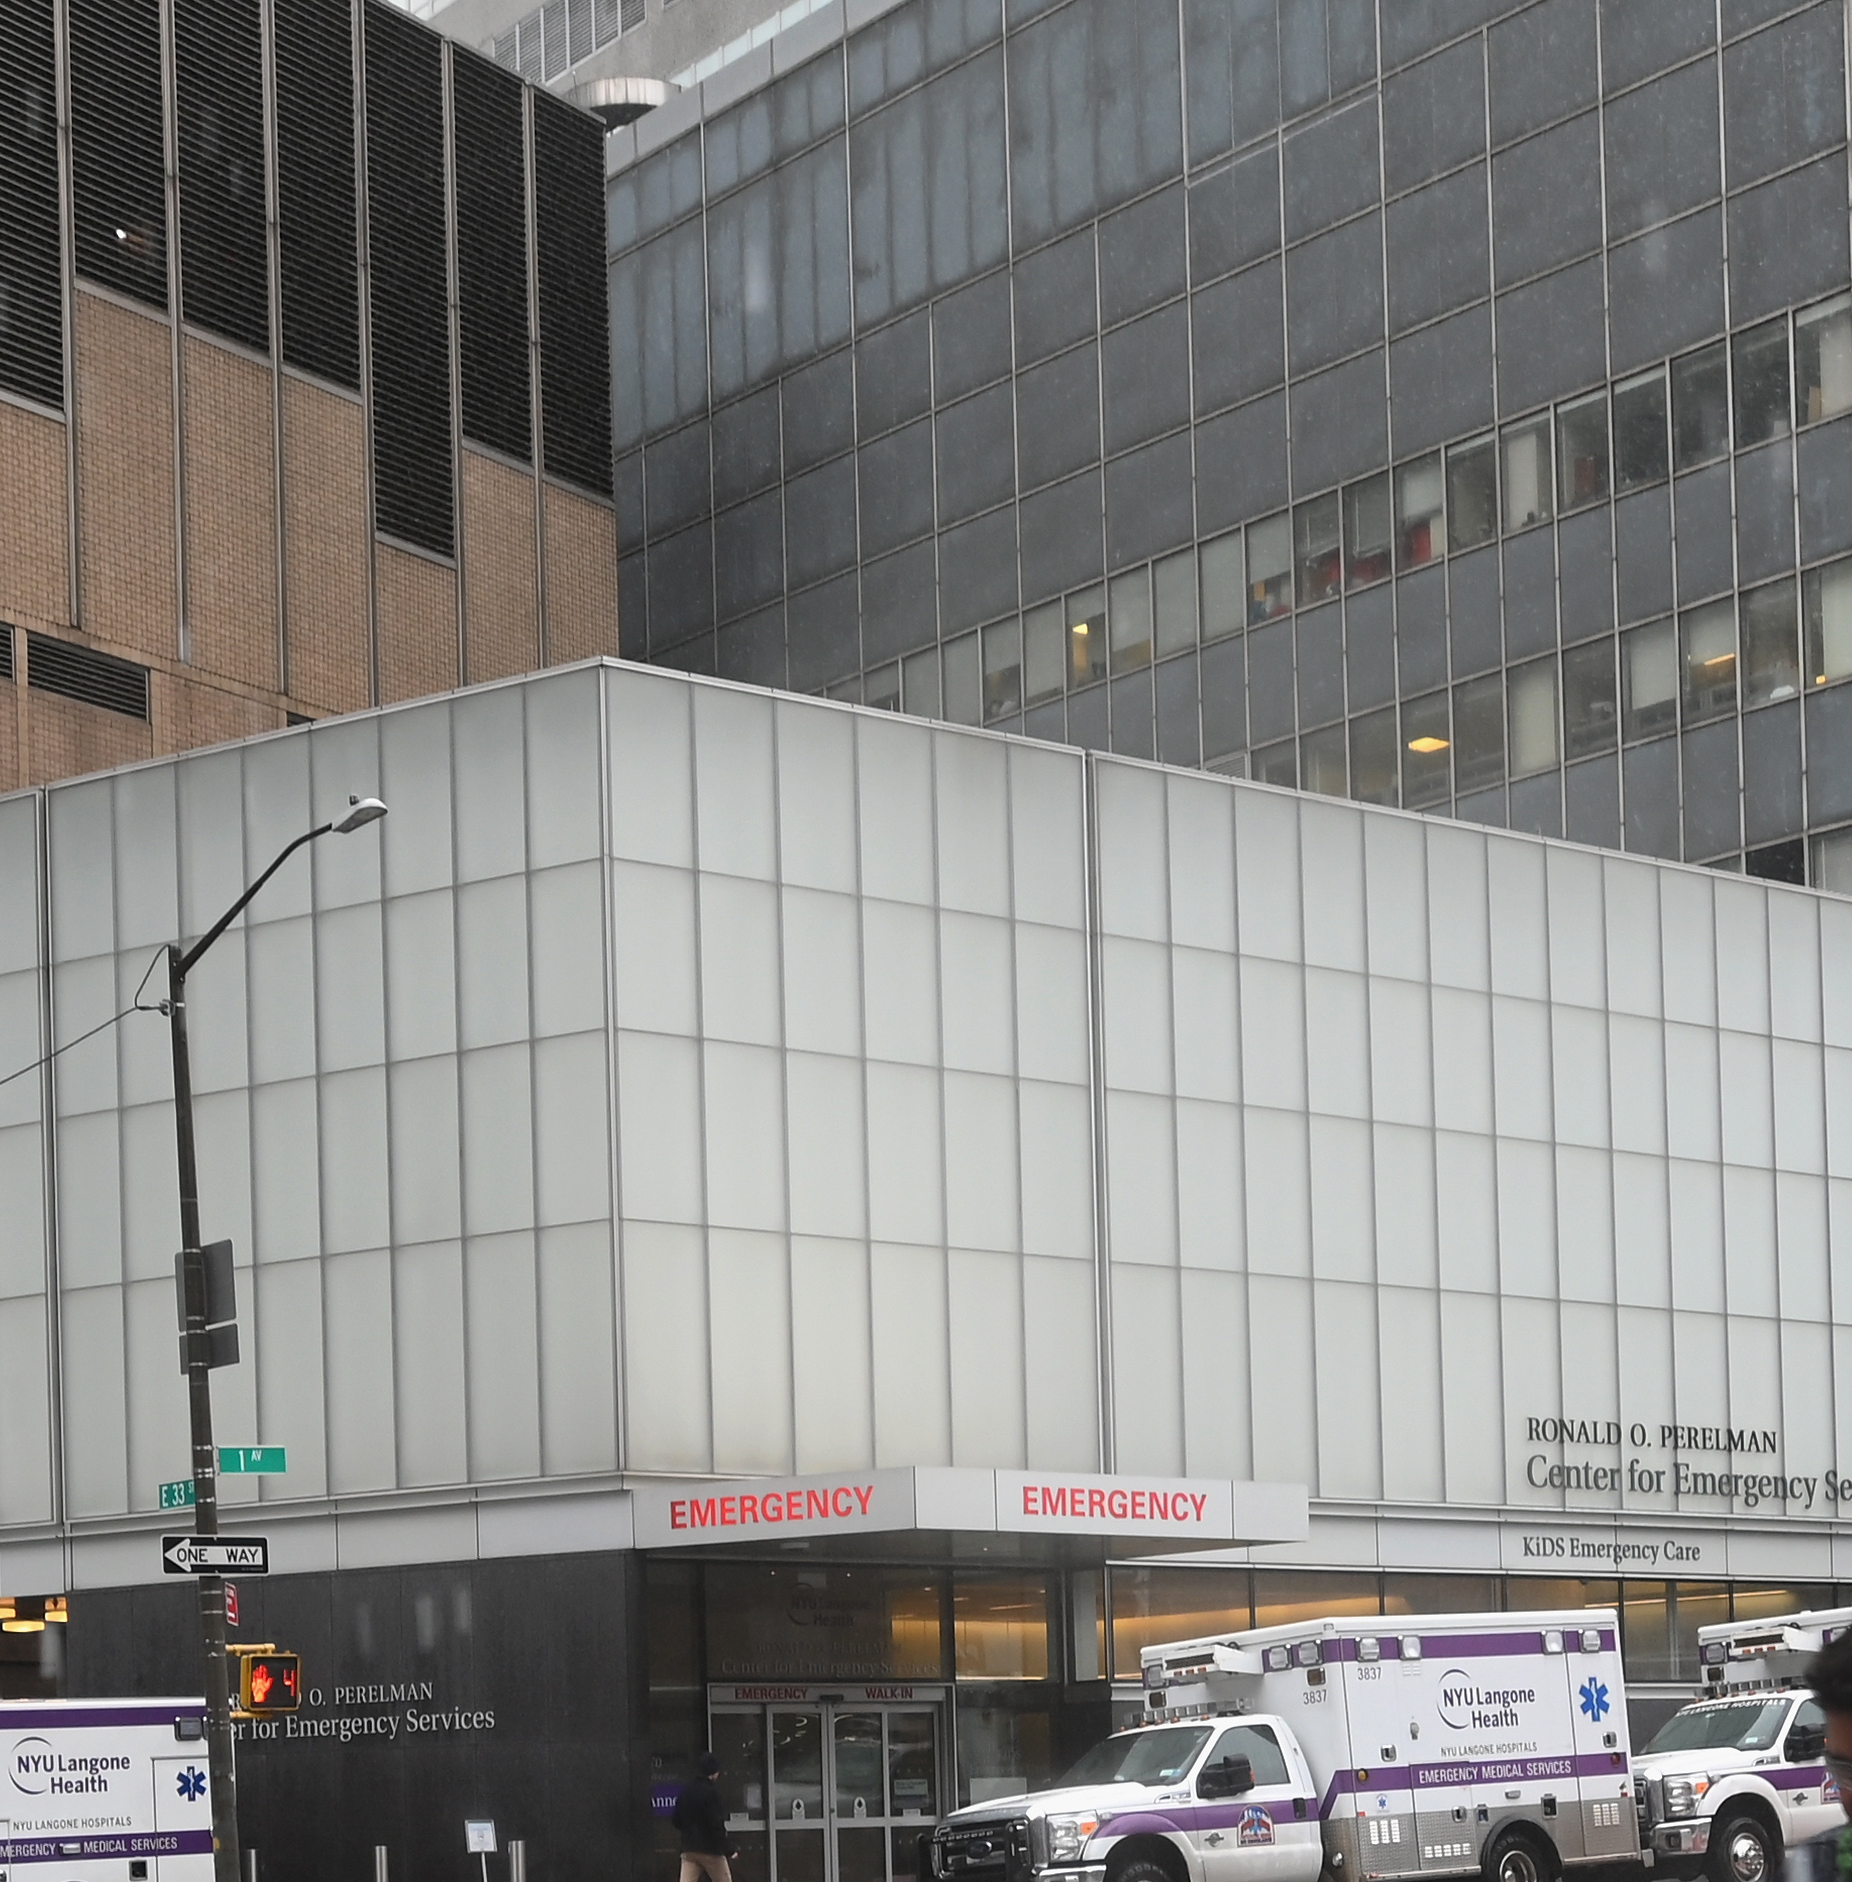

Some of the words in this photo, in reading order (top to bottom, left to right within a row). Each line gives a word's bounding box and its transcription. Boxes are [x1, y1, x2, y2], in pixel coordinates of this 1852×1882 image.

[1527, 1416, 1622, 1446] RONALD
[1629, 1423, 1652, 1448] O.
[1660, 1424, 1777, 1455] PERELMAN
[238, 1449, 246, 1472] 1
[251, 1449, 263, 1461] AV
[1526, 1454, 1621, 1491] Center
[1628, 1458, 1666, 1494] for
[1674, 1462, 1818, 1509] Emergency
[162, 1486, 169, 1507] E
[172, 1483, 185, 1505] 33
[1023, 1486, 1207, 1522] EMERGENCY
[670, 1485, 874, 1530] EMERGENCY
[176, 1548, 208, 1563] ONE
[226, 1548, 258, 1563] WAY
[1523, 1536, 1565, 1558] KiDS
[1569, 1538, 1660, 1565] Emergency
[1663, 1540, 1701, 1563] Care
[283, 1669, 296, 1697] 4
[1357, 1667, 1382, 1681] 3837
[309, 1688, 326, 1706] O.
[335, 1682, 433, 1705] PERELMAN
[734, 1687, 808, 1700] EMERGENCY
[865, 1687, 914, 1700] WALK-IN
[1303, 1689, 1328, 1705] 3837
[1443, 1687, 1475, 1708] NYU
[1476, 1686, 1535, 1709] Langone
[1731, 1699, 1786, 1709] HOSPITALS
[285, 1713, 400, 1742] Emergency
[406, 1705, 495, 1733] Services
[1471, 1707, 1519, 1729] Health
[1441, 1747, 1457, 1758] NYU
[1458, 1744, 1495, 1757] LANGONE
[1496, 1741, 1538, 1754] HOSPITALS
[17, 1755, 55, 1774] NYU
[58, 1753, 131, 1775] Langone
[1419, 1767, 1479, 1785] EMERGENCY
[1481, 1763, 1524, 1781] MEDICAL
[1526, 1760, 1572, 1777] SERVICES
[50, 1775, 109, 1794] Health
[13, 1820, 33, 1831] NYU
[34, 1819, 80, 1831] LANGONE
[81, 1816, 132, 1829] HOSPITALS
[83, 1840, 127, 1854] MEDICAL
[130, 1837, 178, 1851] SERVICES
